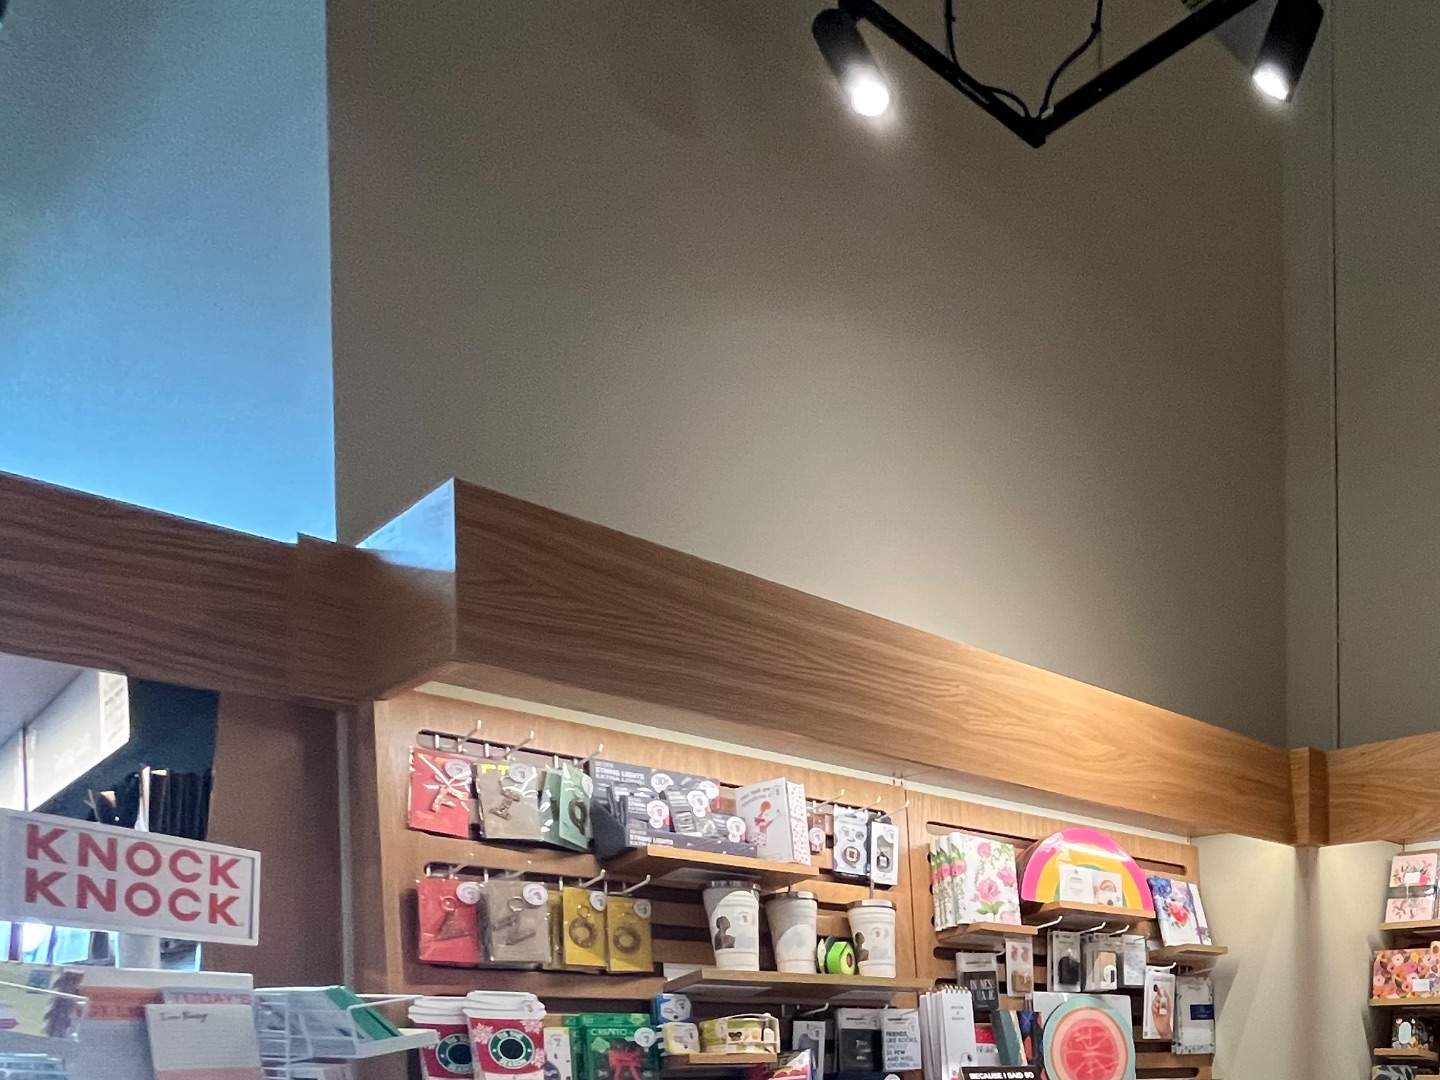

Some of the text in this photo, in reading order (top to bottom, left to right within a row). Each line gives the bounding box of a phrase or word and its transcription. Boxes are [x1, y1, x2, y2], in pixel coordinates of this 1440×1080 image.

[25, 823, 240, 890] KNOCK
[24, 867, 240, 928] KNOCK
[968, 1072, 1003, 1080] BECAUSE
[1007, 1071, 1024, 1080] SAID
[1024, 1071, 1035, 1079] SO
